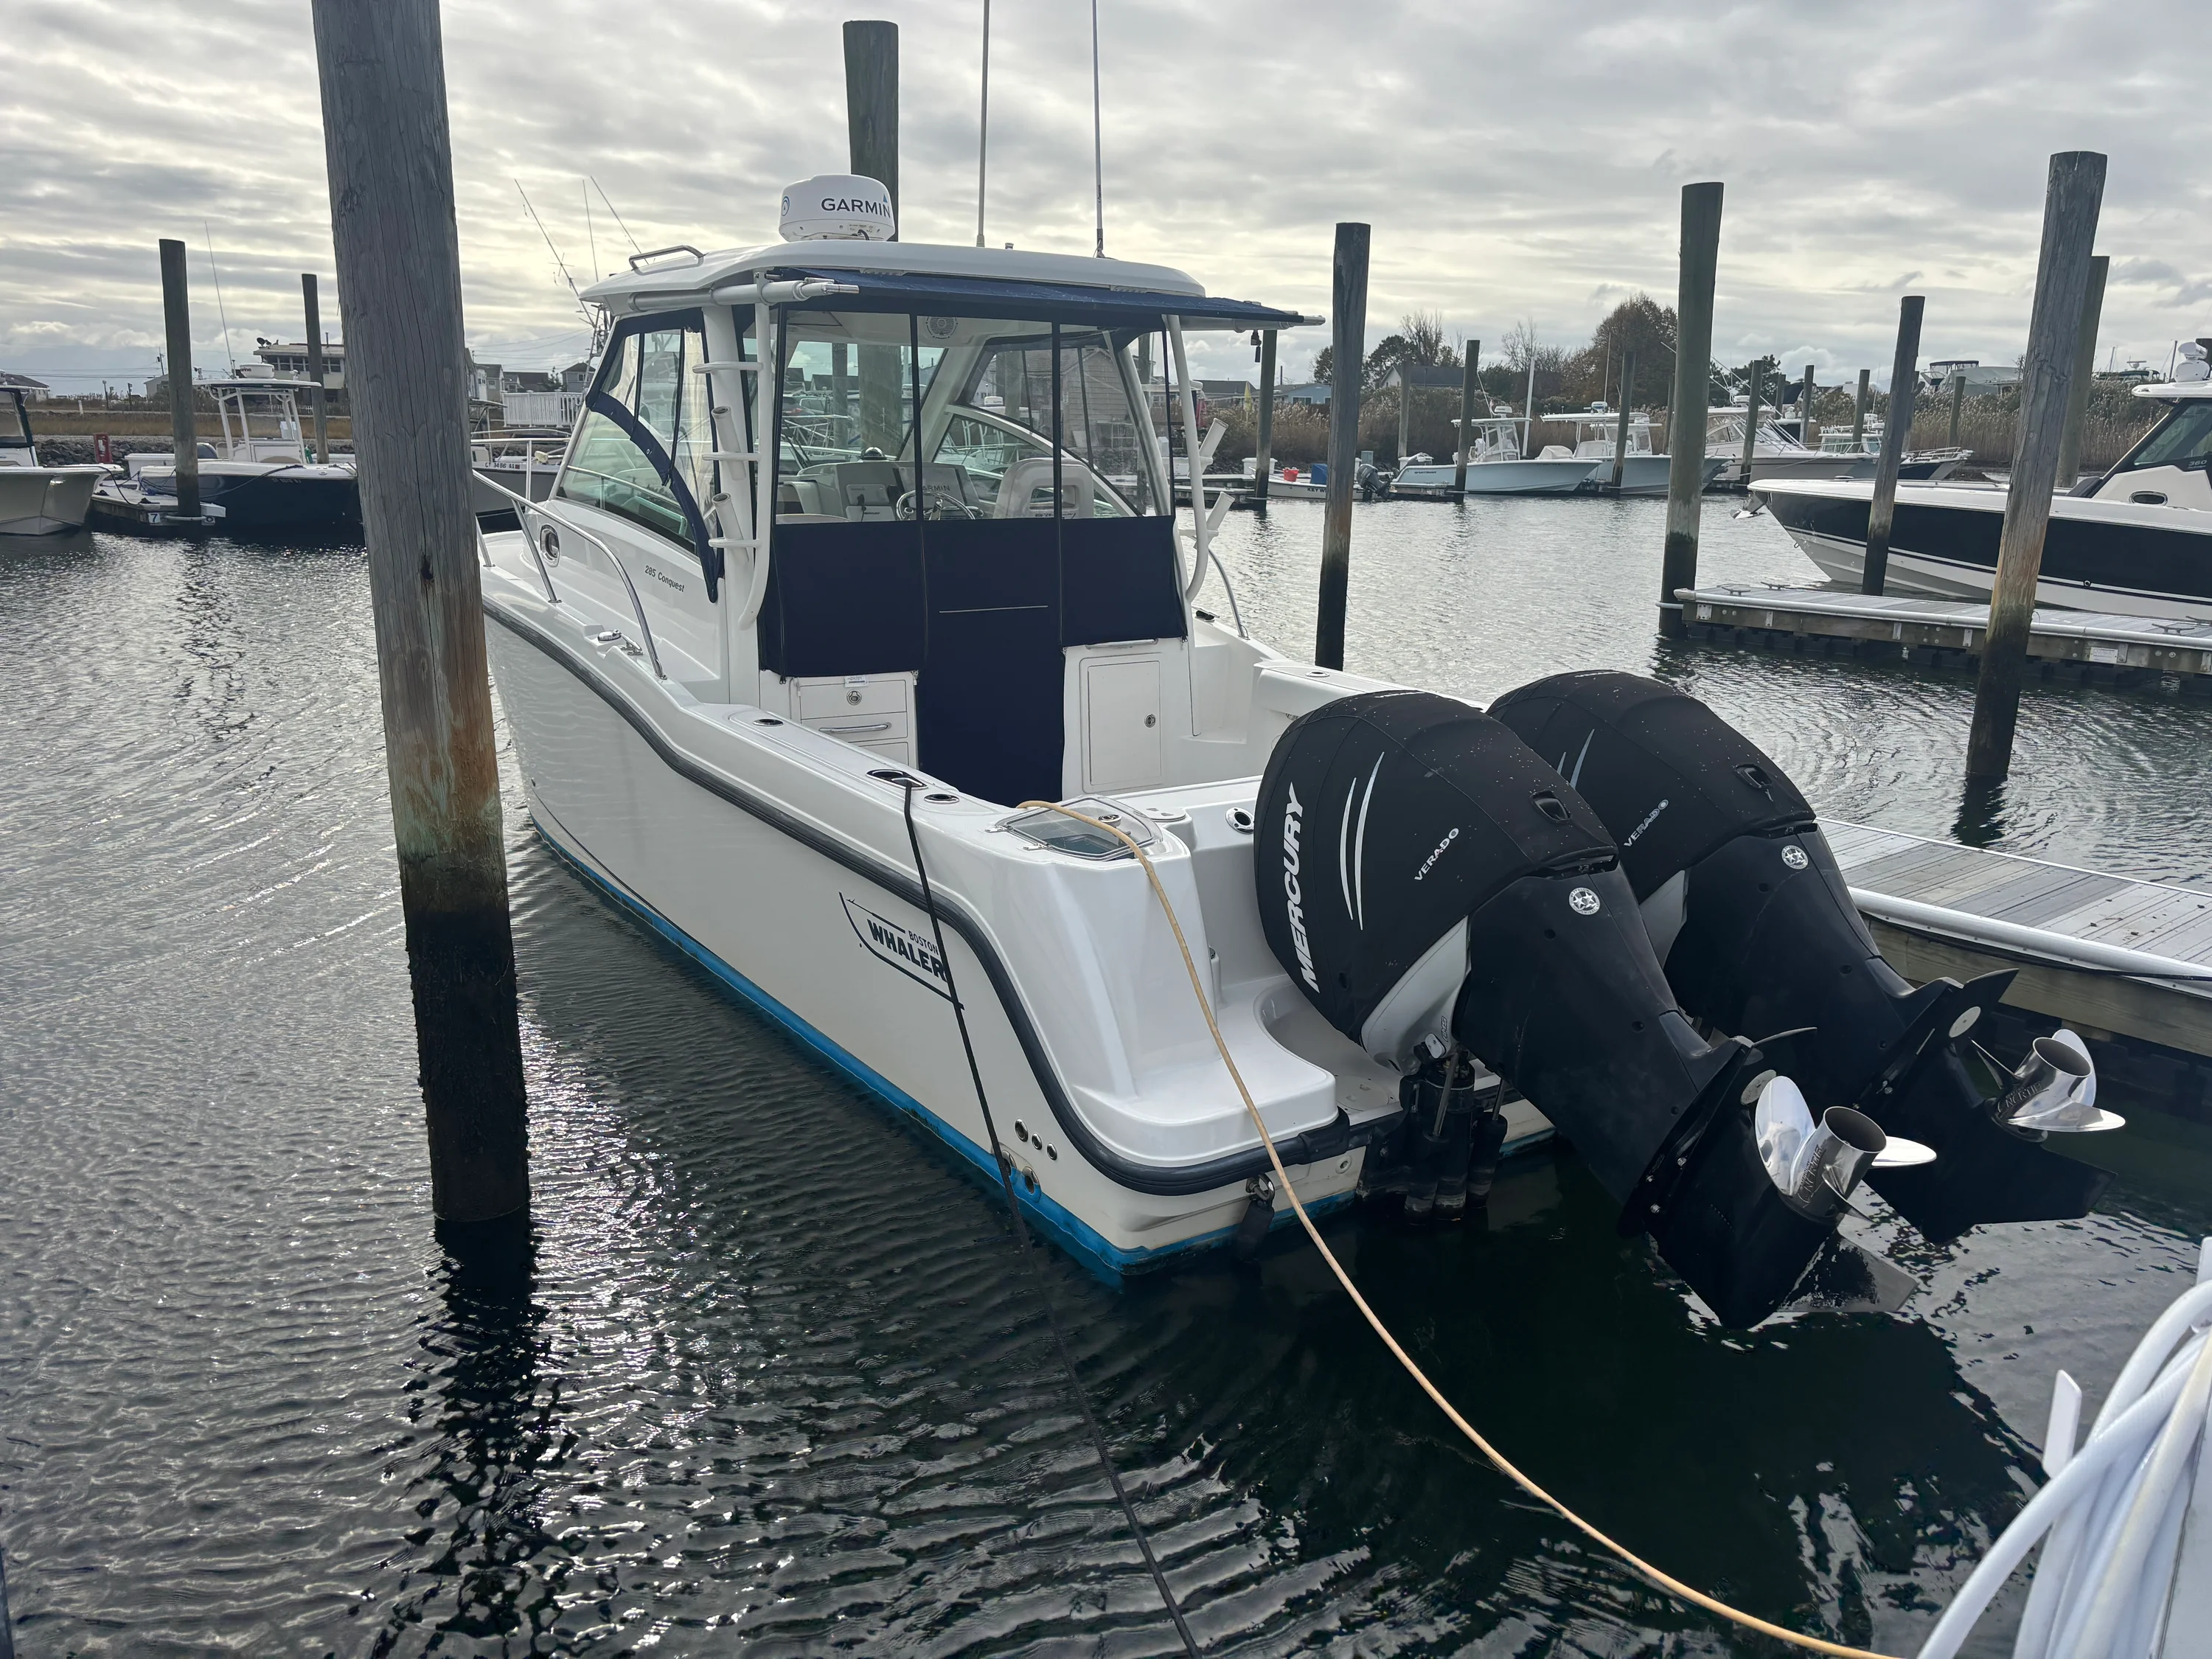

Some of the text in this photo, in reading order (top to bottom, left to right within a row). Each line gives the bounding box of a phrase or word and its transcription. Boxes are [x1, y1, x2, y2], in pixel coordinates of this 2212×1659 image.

[821, 198, 891, 218] GARMIN
[150, 513, 158, 522] 7
[644, 565, 685, 593] 285 Conquest
[1624, 799, 1669, 847] VERADO
[1413, 827, 1459, 882] VERADO
[1283, 782, 1321, 994] MERCURY
[866, 918, 948, 983] WHALER
[908, 930, 939, 956] BOSTON
